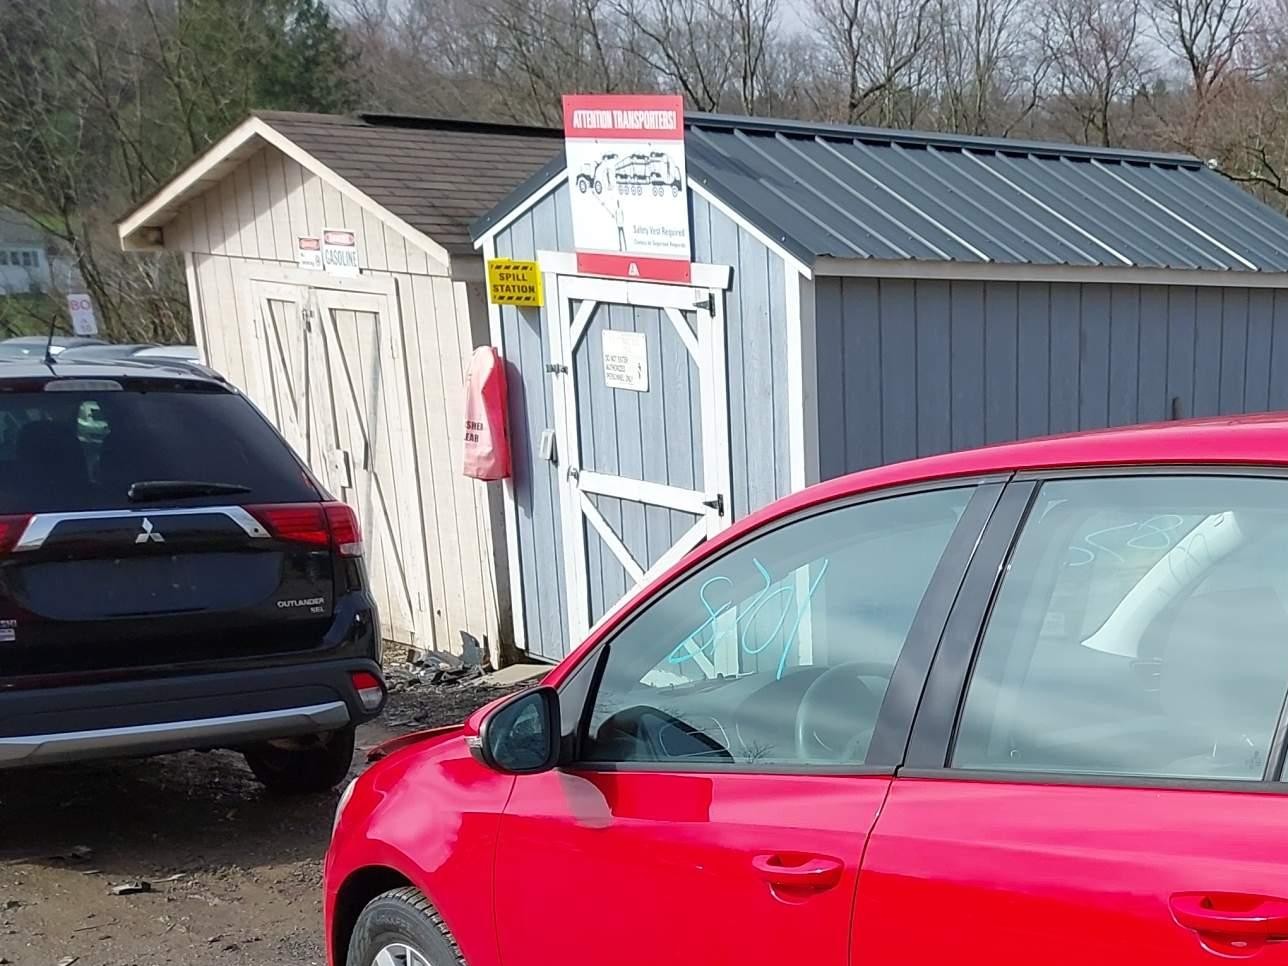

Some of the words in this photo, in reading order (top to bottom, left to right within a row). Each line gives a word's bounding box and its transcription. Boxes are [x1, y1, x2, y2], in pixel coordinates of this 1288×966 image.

[572, 109, 612, 129] ATTENTION
[613, 110, 677, 130] TRANSPORTERS!
[325, 249, 357, 267] GASOLINE
[499, 272, 528, 281] SPILL
[493, 284, 536, 293] STATION
[464, 432, 479, 443] EAR
[276, 597, 325, 608] OUTLANDER
